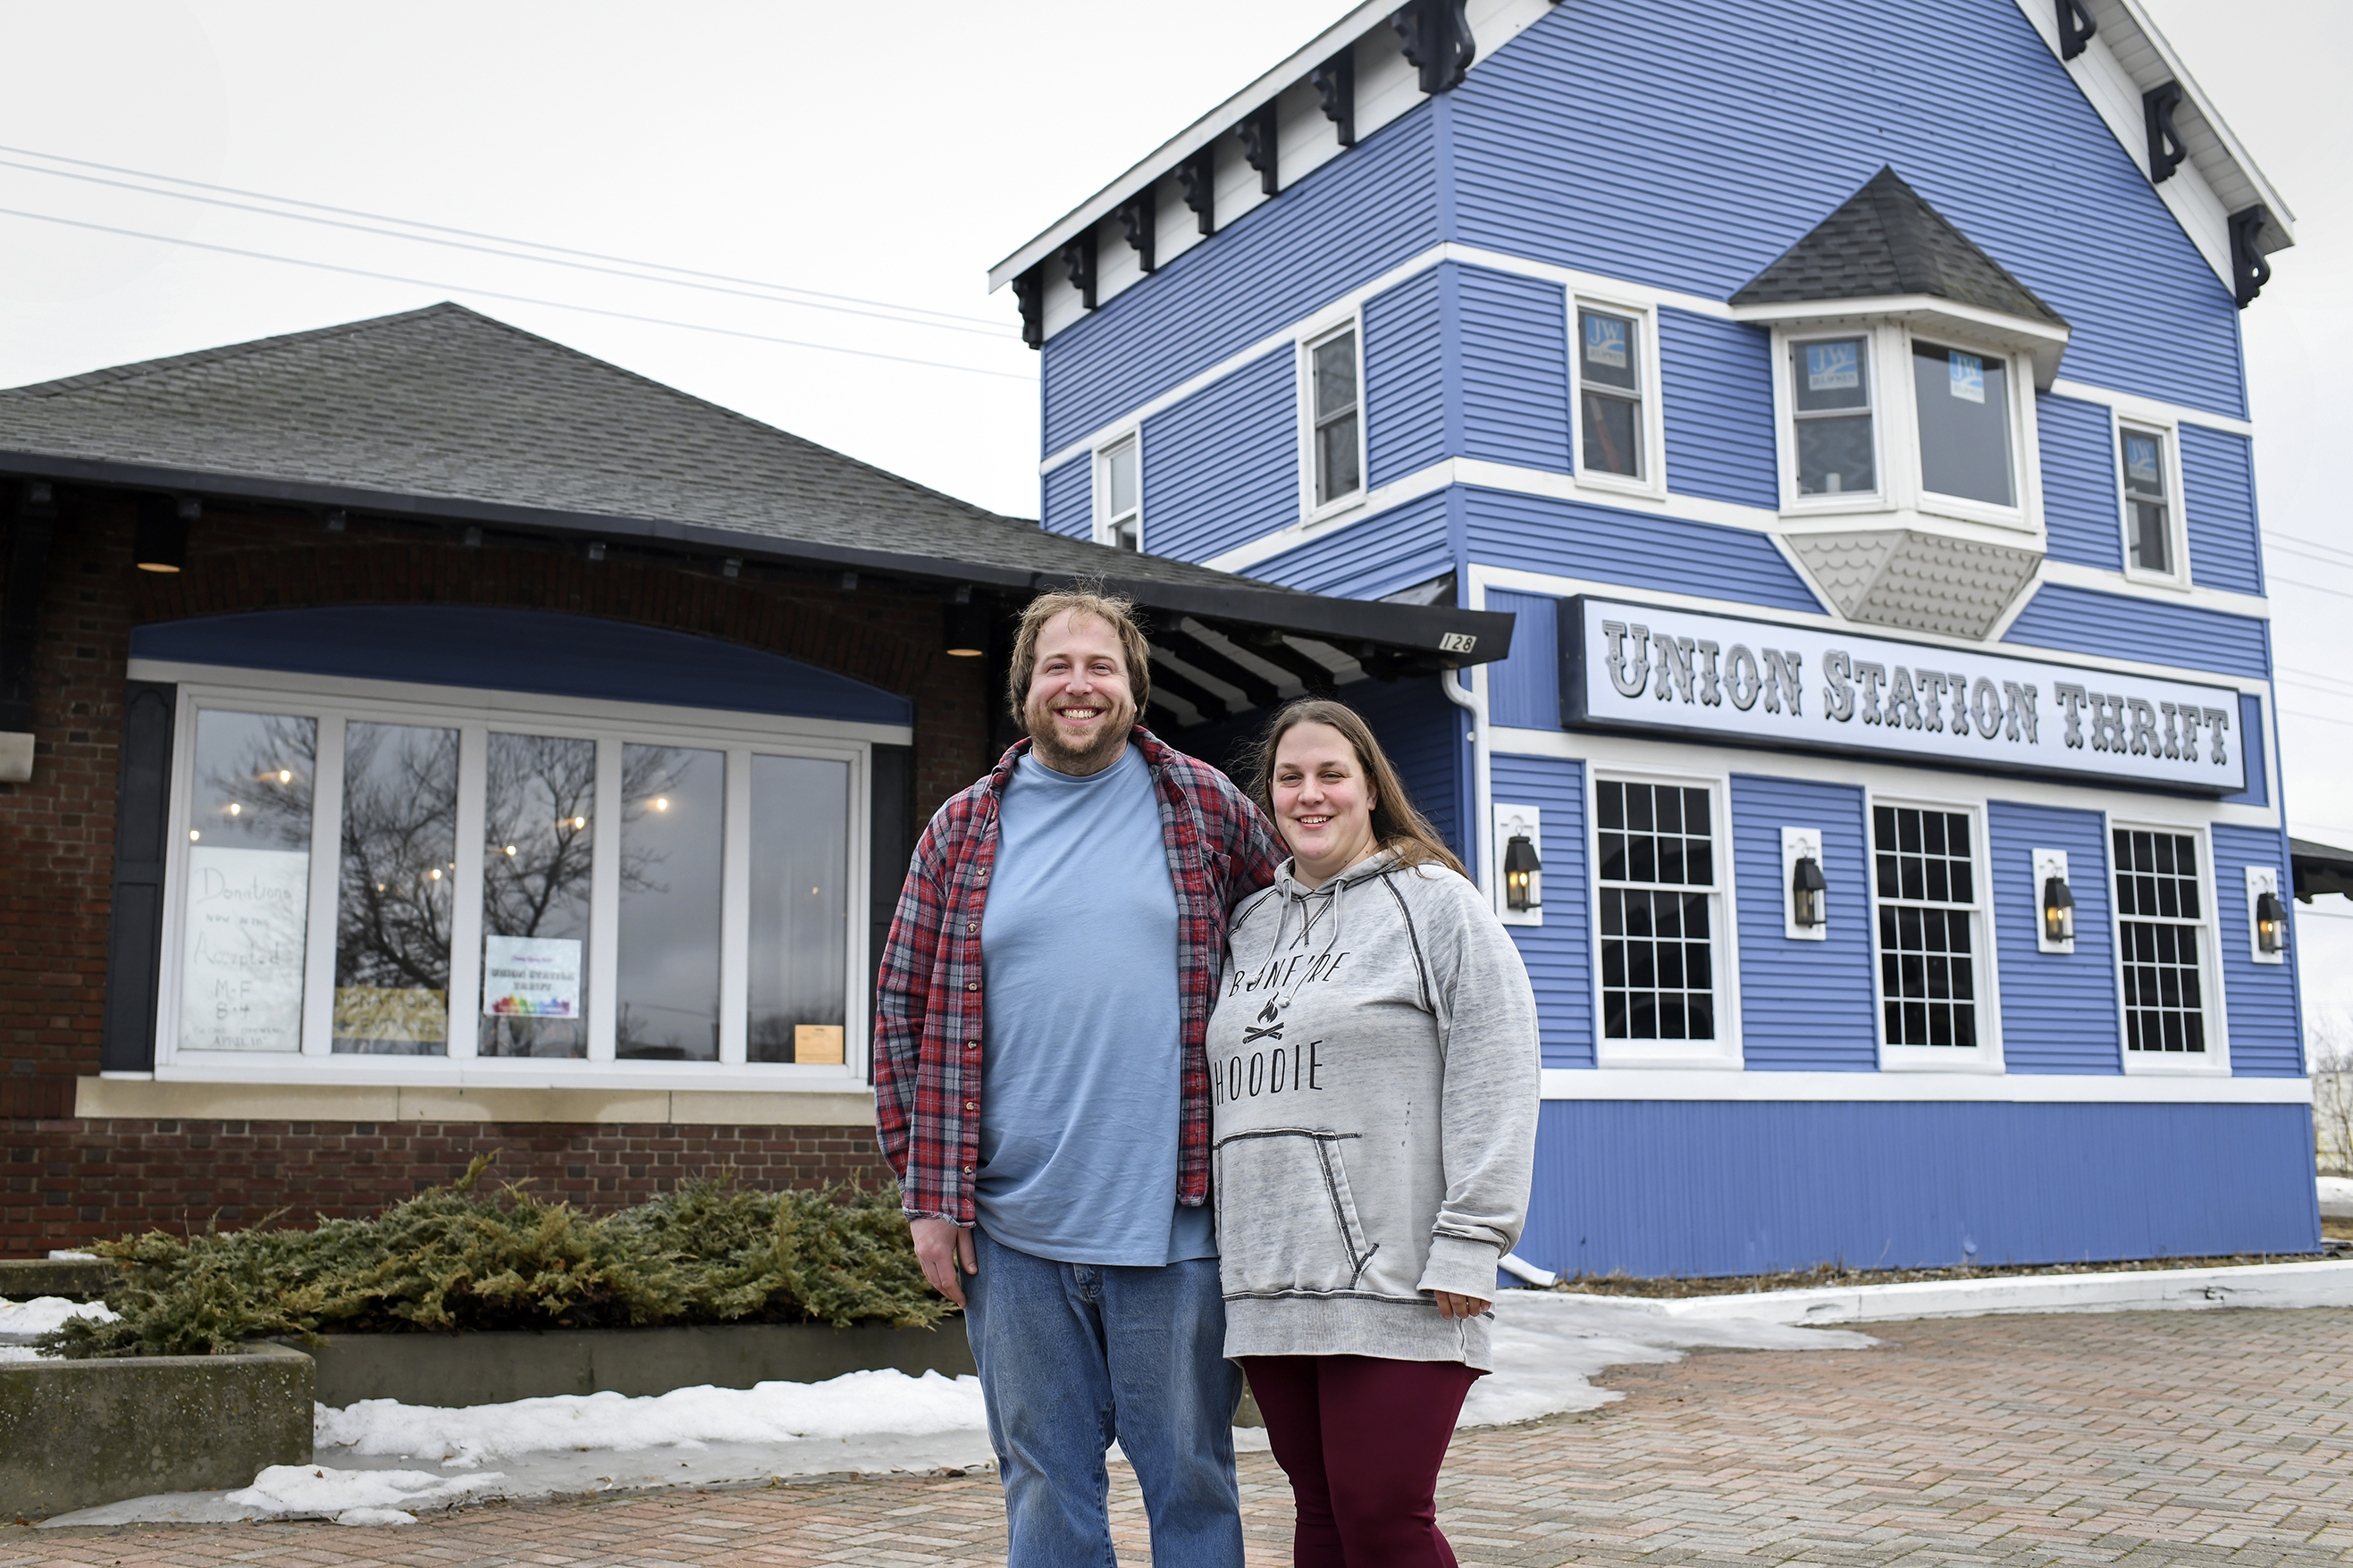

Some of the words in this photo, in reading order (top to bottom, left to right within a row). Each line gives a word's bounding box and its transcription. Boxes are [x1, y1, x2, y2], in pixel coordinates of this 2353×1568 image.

[1443, 633, 1474, 651] 128
[1601, 619, 1803, 716] UNION
[1822, 649, 2039, 745] STATION
[2055, 681, 2229, 767] THRIFT
[1214, 1039, 1324, 1107] HOODIE
